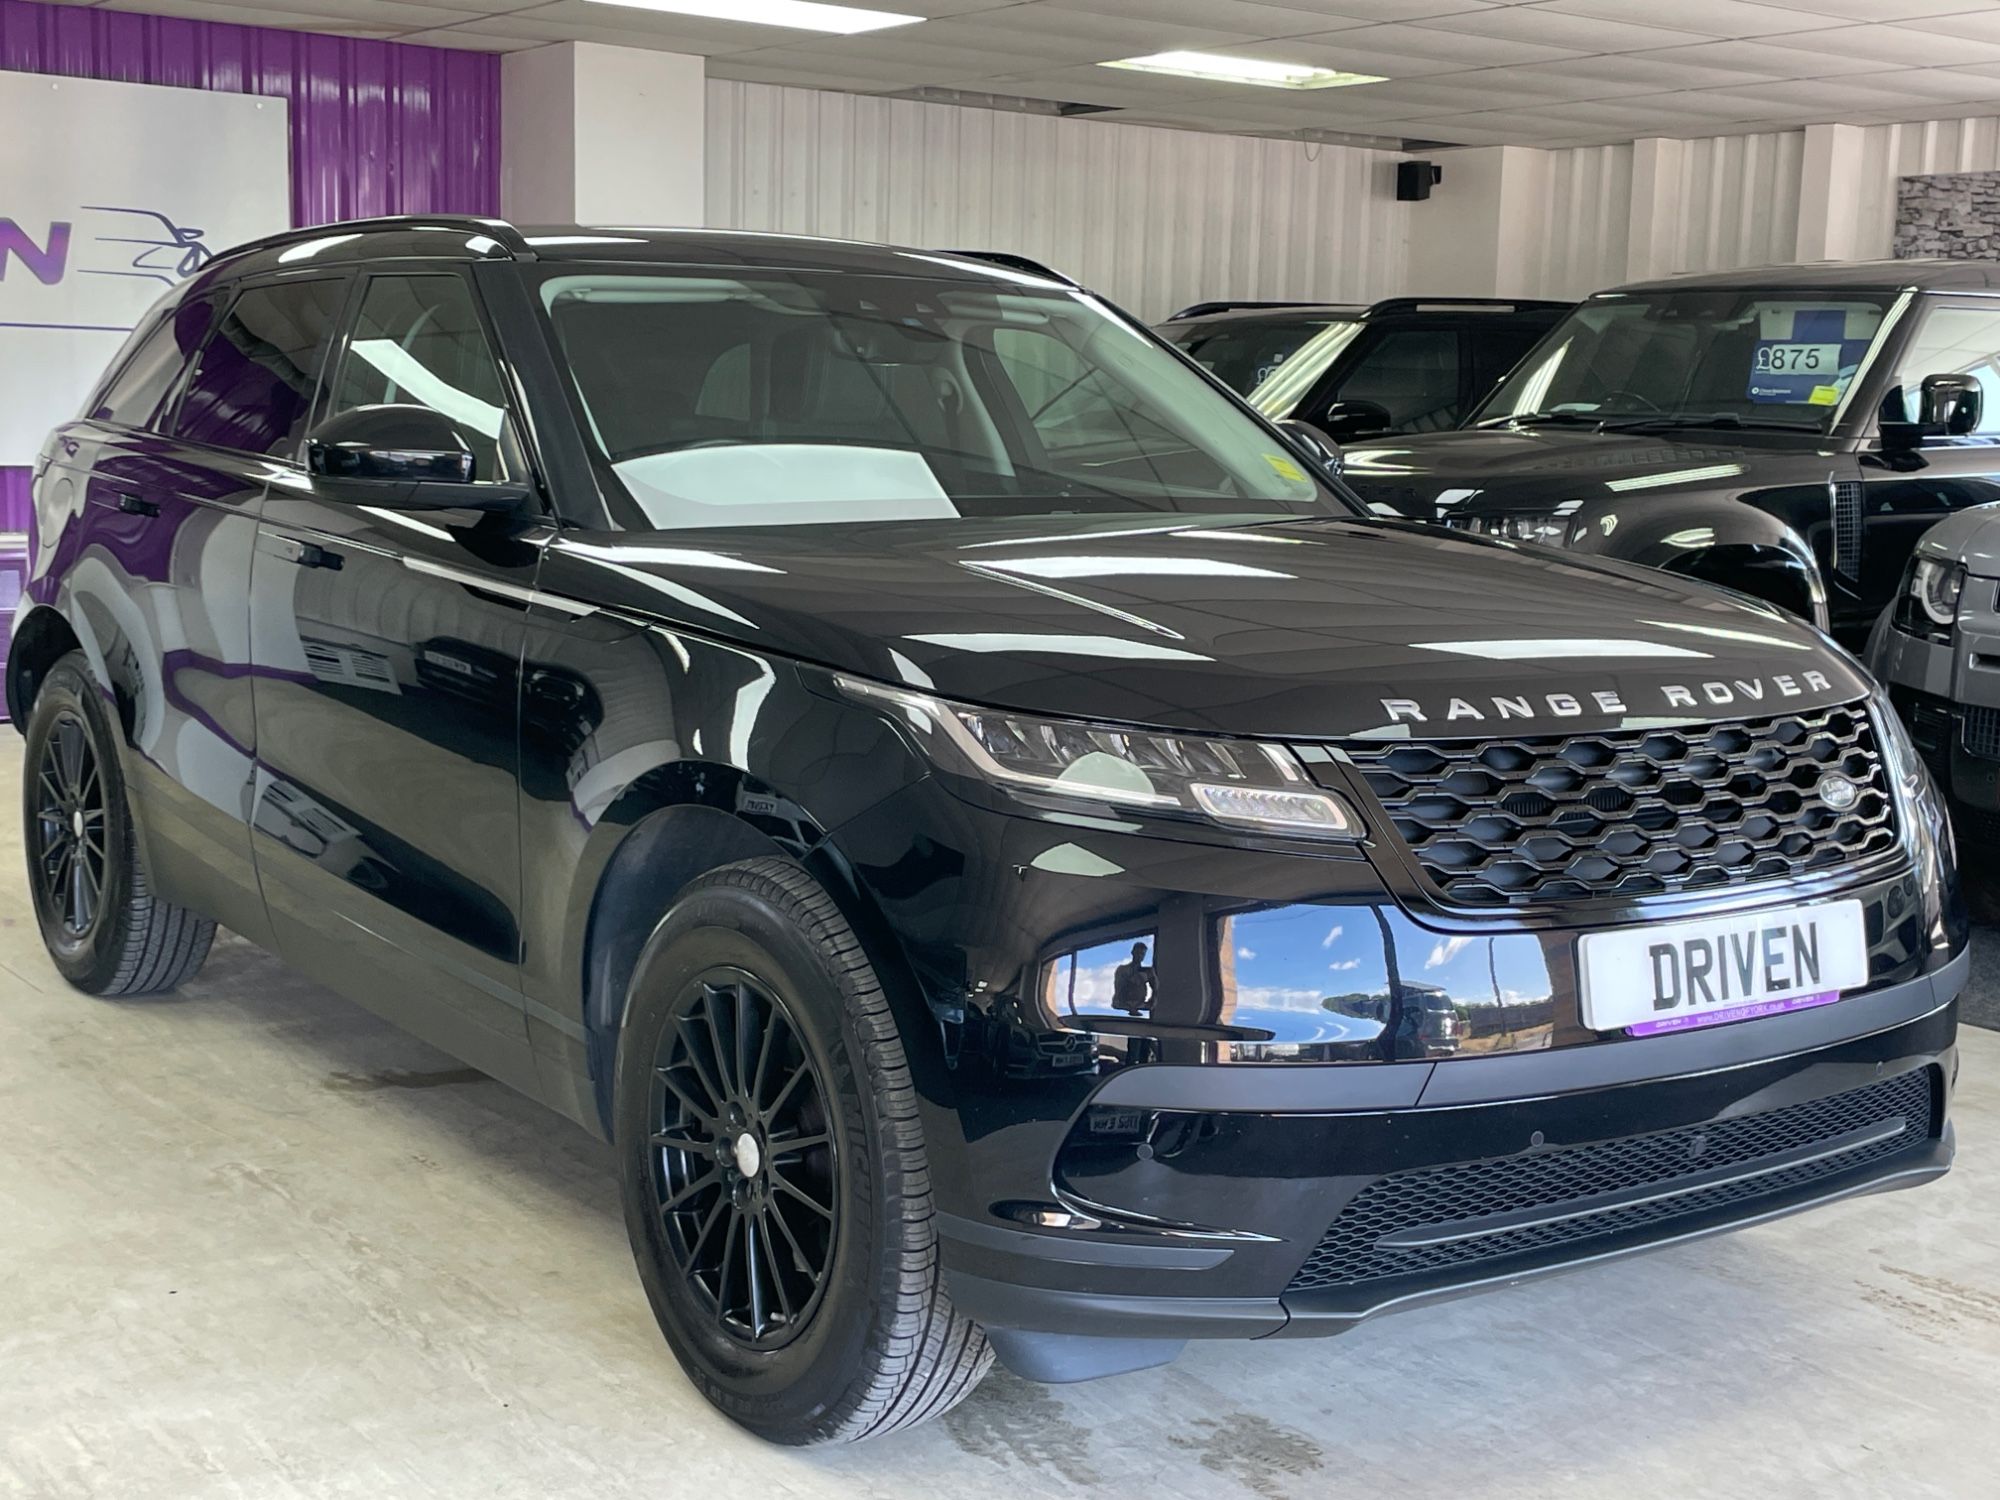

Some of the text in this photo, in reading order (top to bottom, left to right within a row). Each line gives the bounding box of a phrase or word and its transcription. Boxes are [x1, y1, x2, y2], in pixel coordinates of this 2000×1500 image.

[1381, 670, 1832, 722] RANGE ROVER
[1649, 922, 1821, 1011] DRIVEN
